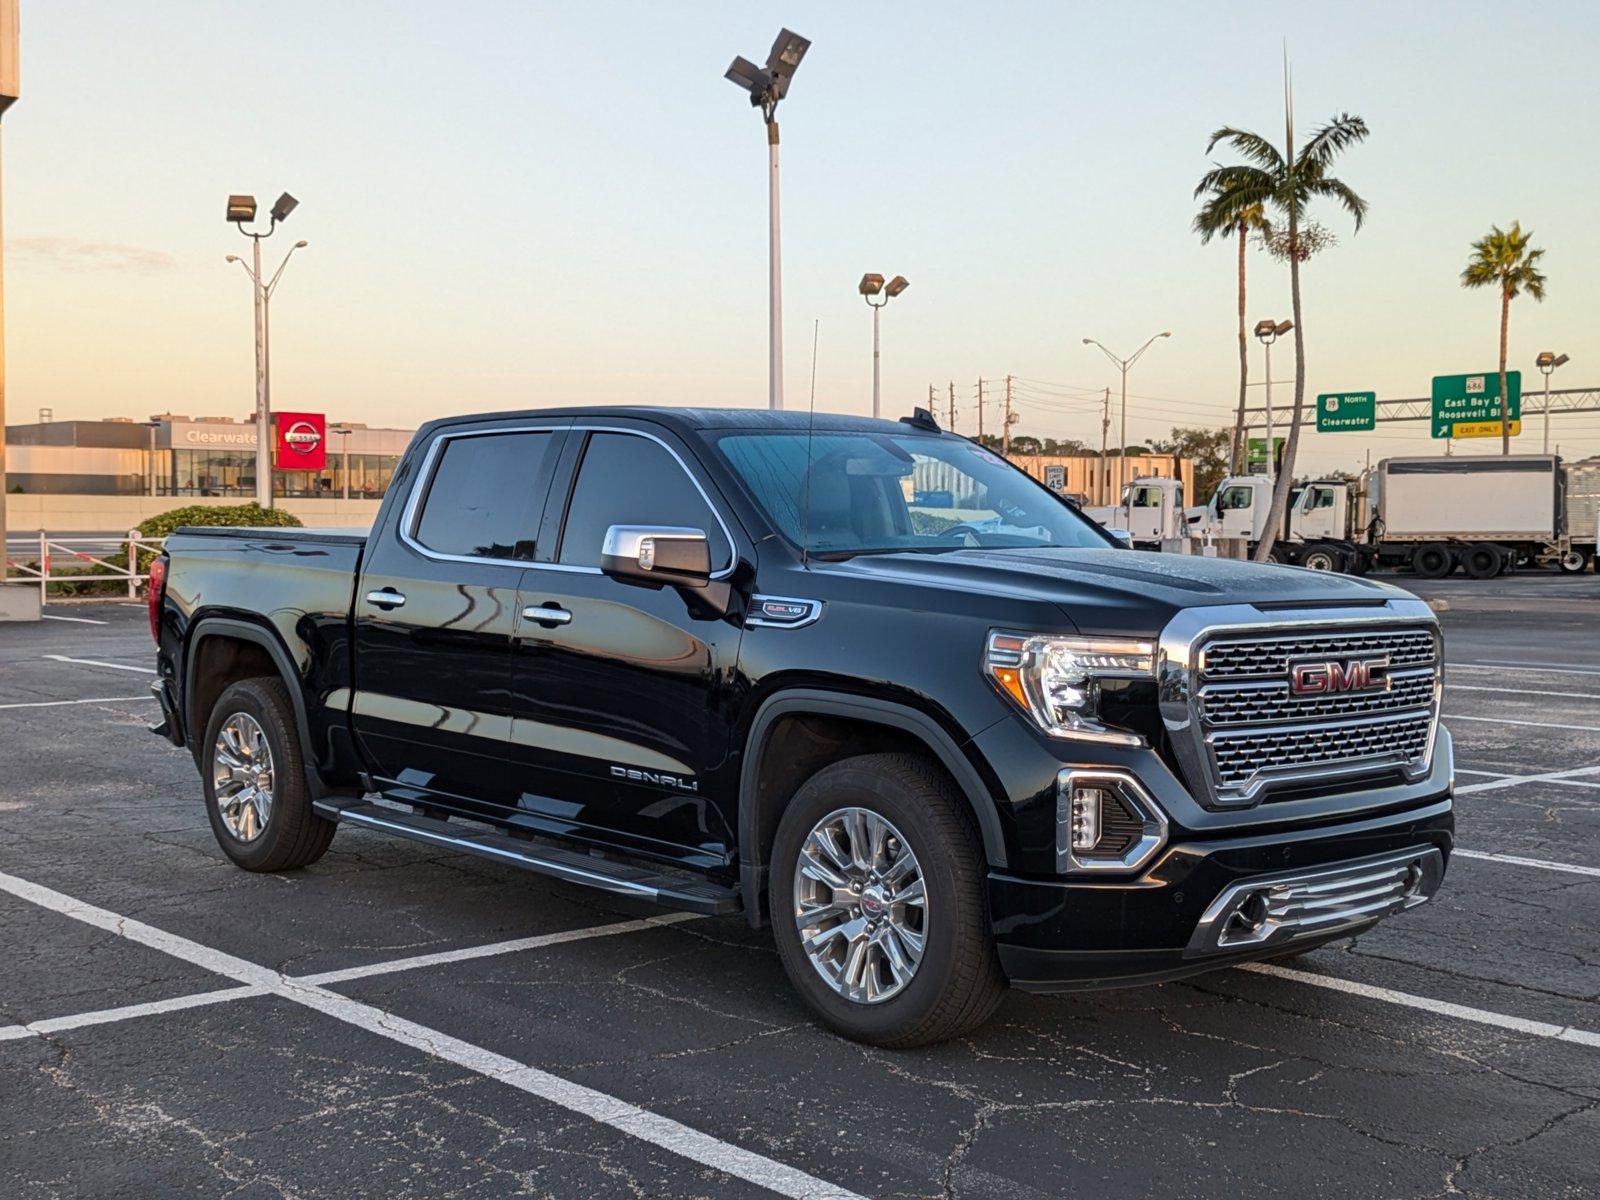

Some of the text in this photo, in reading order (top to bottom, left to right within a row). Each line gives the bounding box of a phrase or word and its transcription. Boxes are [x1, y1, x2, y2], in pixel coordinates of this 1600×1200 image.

[1328, 400, 1336, 409] 19
[1444, 398, 1466, 408] East
[1470, 397, 1490, 407] Bay
[1438, 407, 1513, 419] Roosevelt Bld
[1321, 417, 1370, 426] Clearwater
[1460, 425, 1499, 434] EXIT ONLY
[186, 430, 258, 444] Clearwate
[1049, 479, 1063, 490] 45
[1292, 654, 1391, 694] GMC
[610, 765, 698, 791] DENALI
